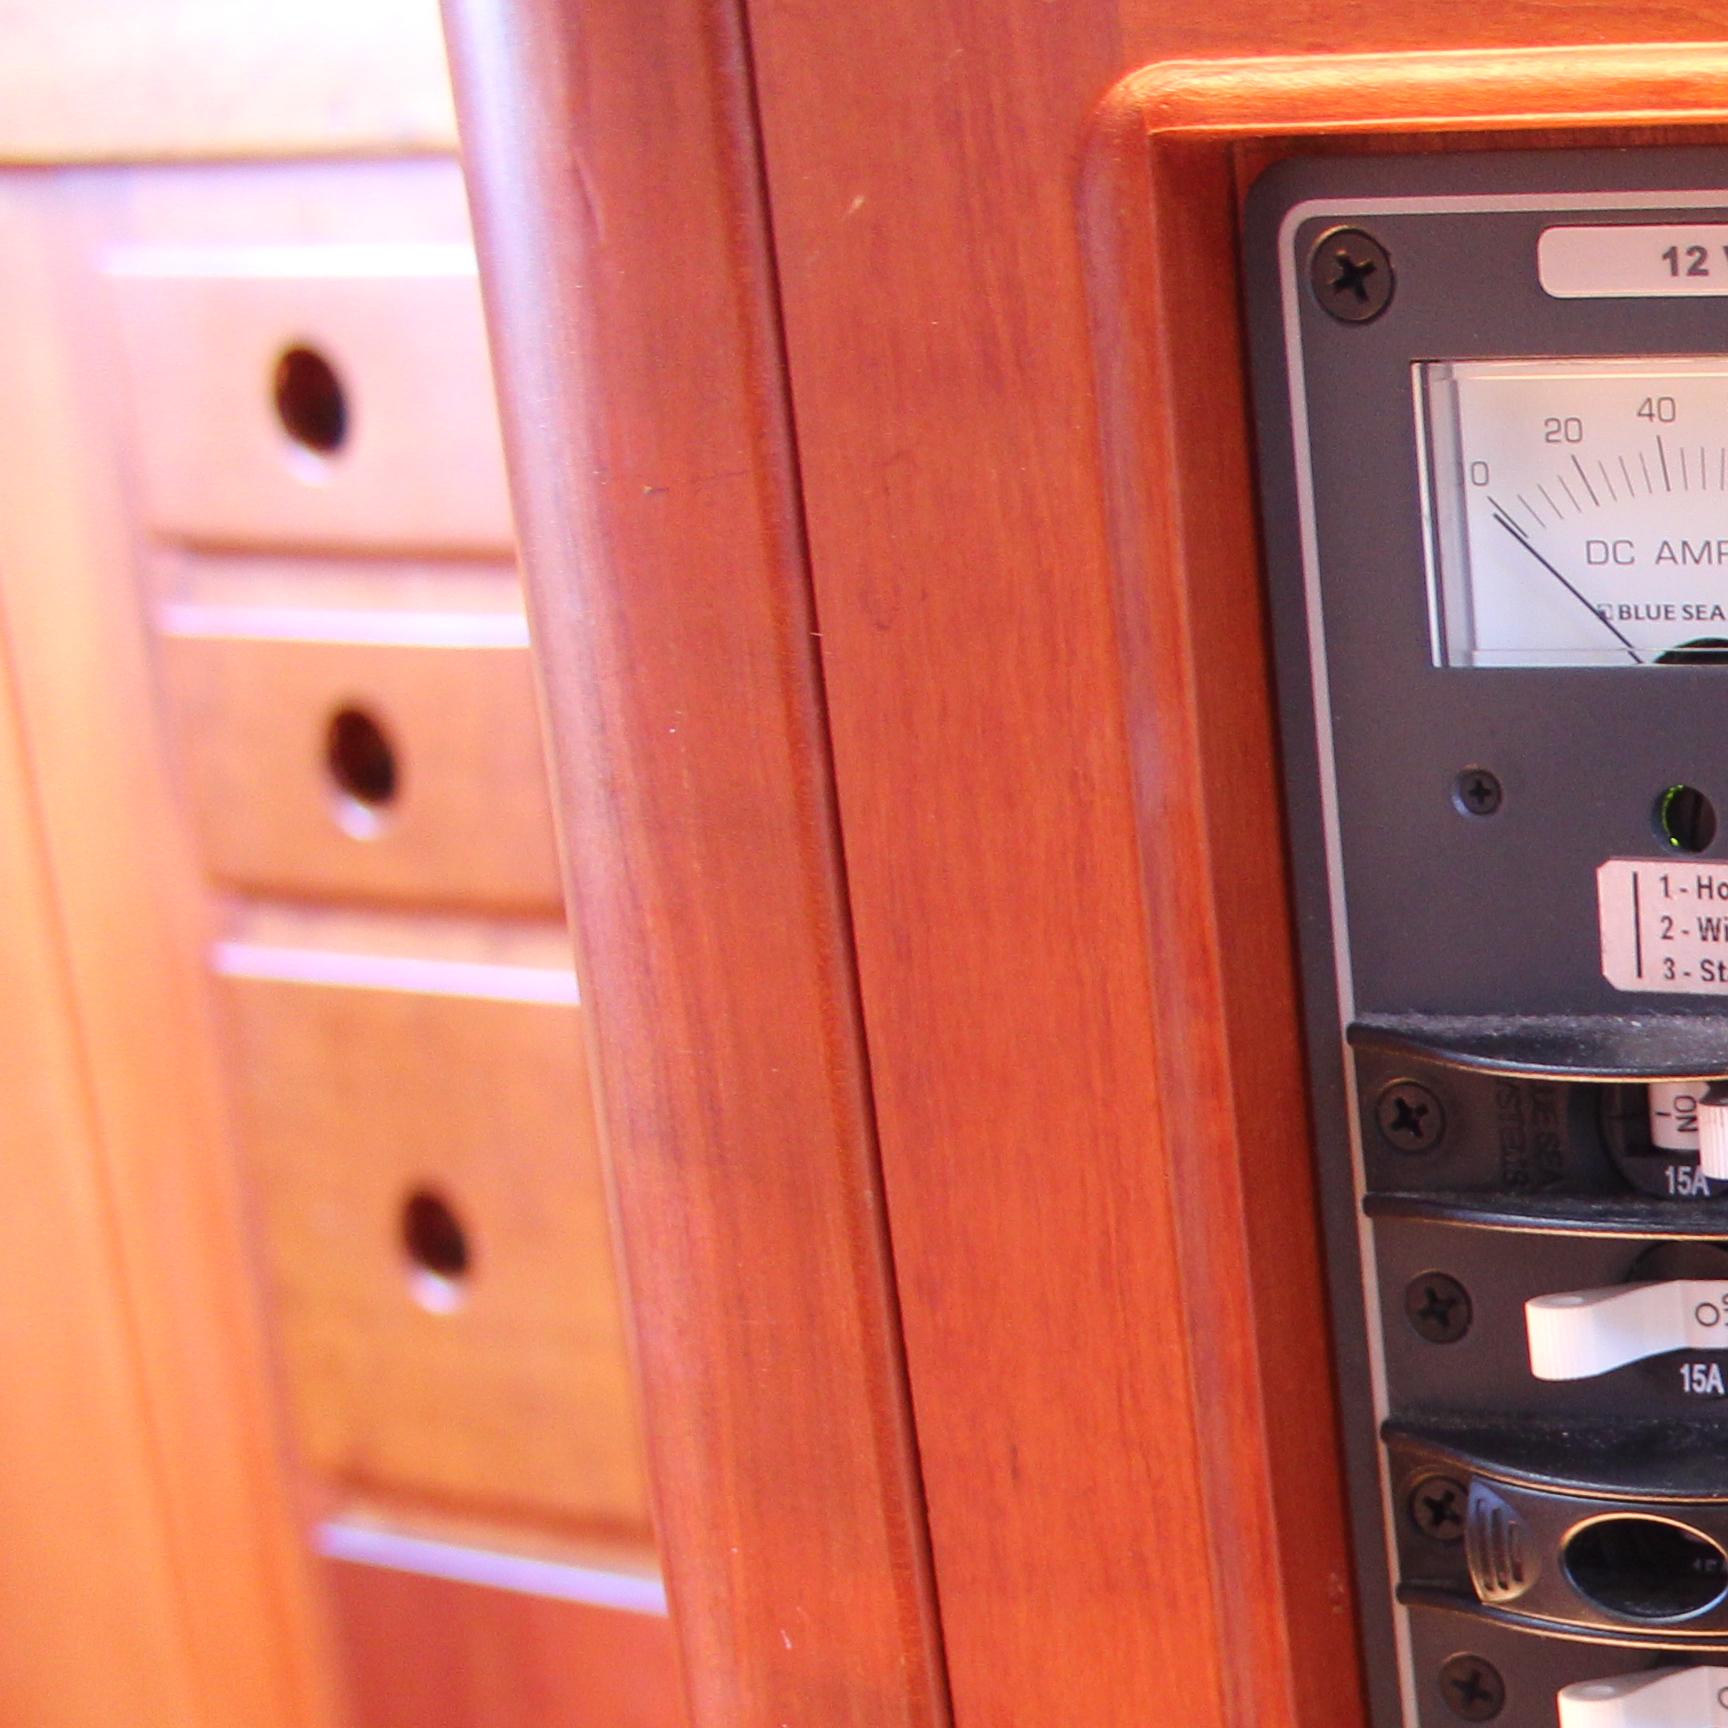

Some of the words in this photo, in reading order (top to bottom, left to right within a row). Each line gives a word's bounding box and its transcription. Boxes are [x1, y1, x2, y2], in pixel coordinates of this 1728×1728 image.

[1661, 245, 1710, 277] 12
[1470, 460, 1490, 487] 0
[1543, 417, 1583, 444] 20
[1636, 396, 1676, 424] 40
[1585, 539, 1636, 566] DC
[1618, 604, 1675, 621] BLUE
[1682, 604, 1726, 621] SEA
[1660, 874, 1671, 899] 1
[1660, 915, 1674, 941] 2
[1663, 957, 1676, 981] 3
[1674, 1095, 1698, 1132] ON
[1665, 1166, 1710, 1196] 15A
[1680, 1363, 1725, 1395] 15A
